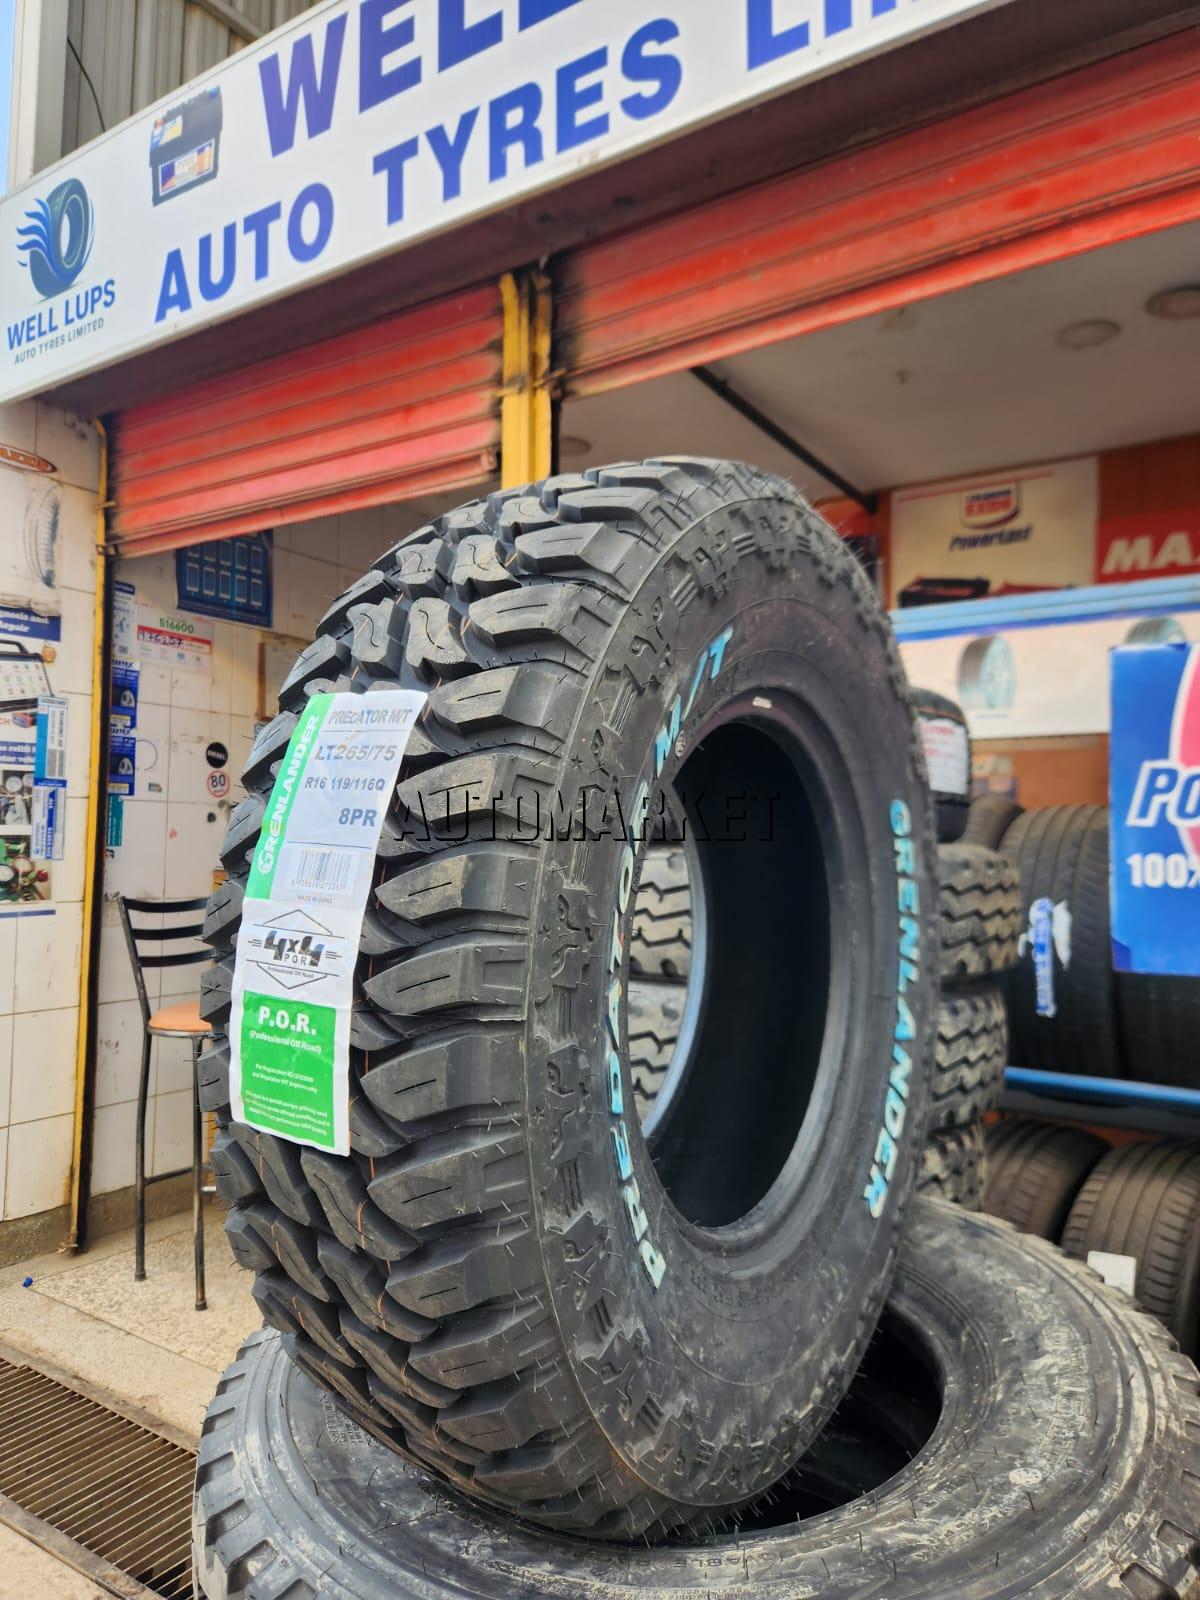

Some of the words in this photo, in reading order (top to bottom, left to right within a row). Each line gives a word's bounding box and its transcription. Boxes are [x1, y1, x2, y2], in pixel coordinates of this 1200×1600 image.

[259, 0, 585, 158] WEL
[155, 182, 334, 323] AUTO
[373, 18, 682, 227] TYRES
[7, 306, 58, 351] WELL
[64, 278, 116, 326] LUPS
[14, 347, 37, 365] AUTO
[38, 334, 66, 355] TYRES
[67, 317, 105, 342] LIMITED
[1101, 531, 1200, 575] MA
[328, 709, 387, 725] PREDATOR
[656, 625, 735, 778] M/T
[314, 745, 398, 761] LT265/75
[211, 774, 226, 788] 80
[257, 715, 319, 874] GRENLANDER
[304, 776, 327, 789] R16
[330, 777, 386, 791] 119/116Q
[338, 808, 378, 827] 8PR
[258, 1006, 317, 1035] P.O.R.
[863, 799, 920, 1219] GRENLANDER
